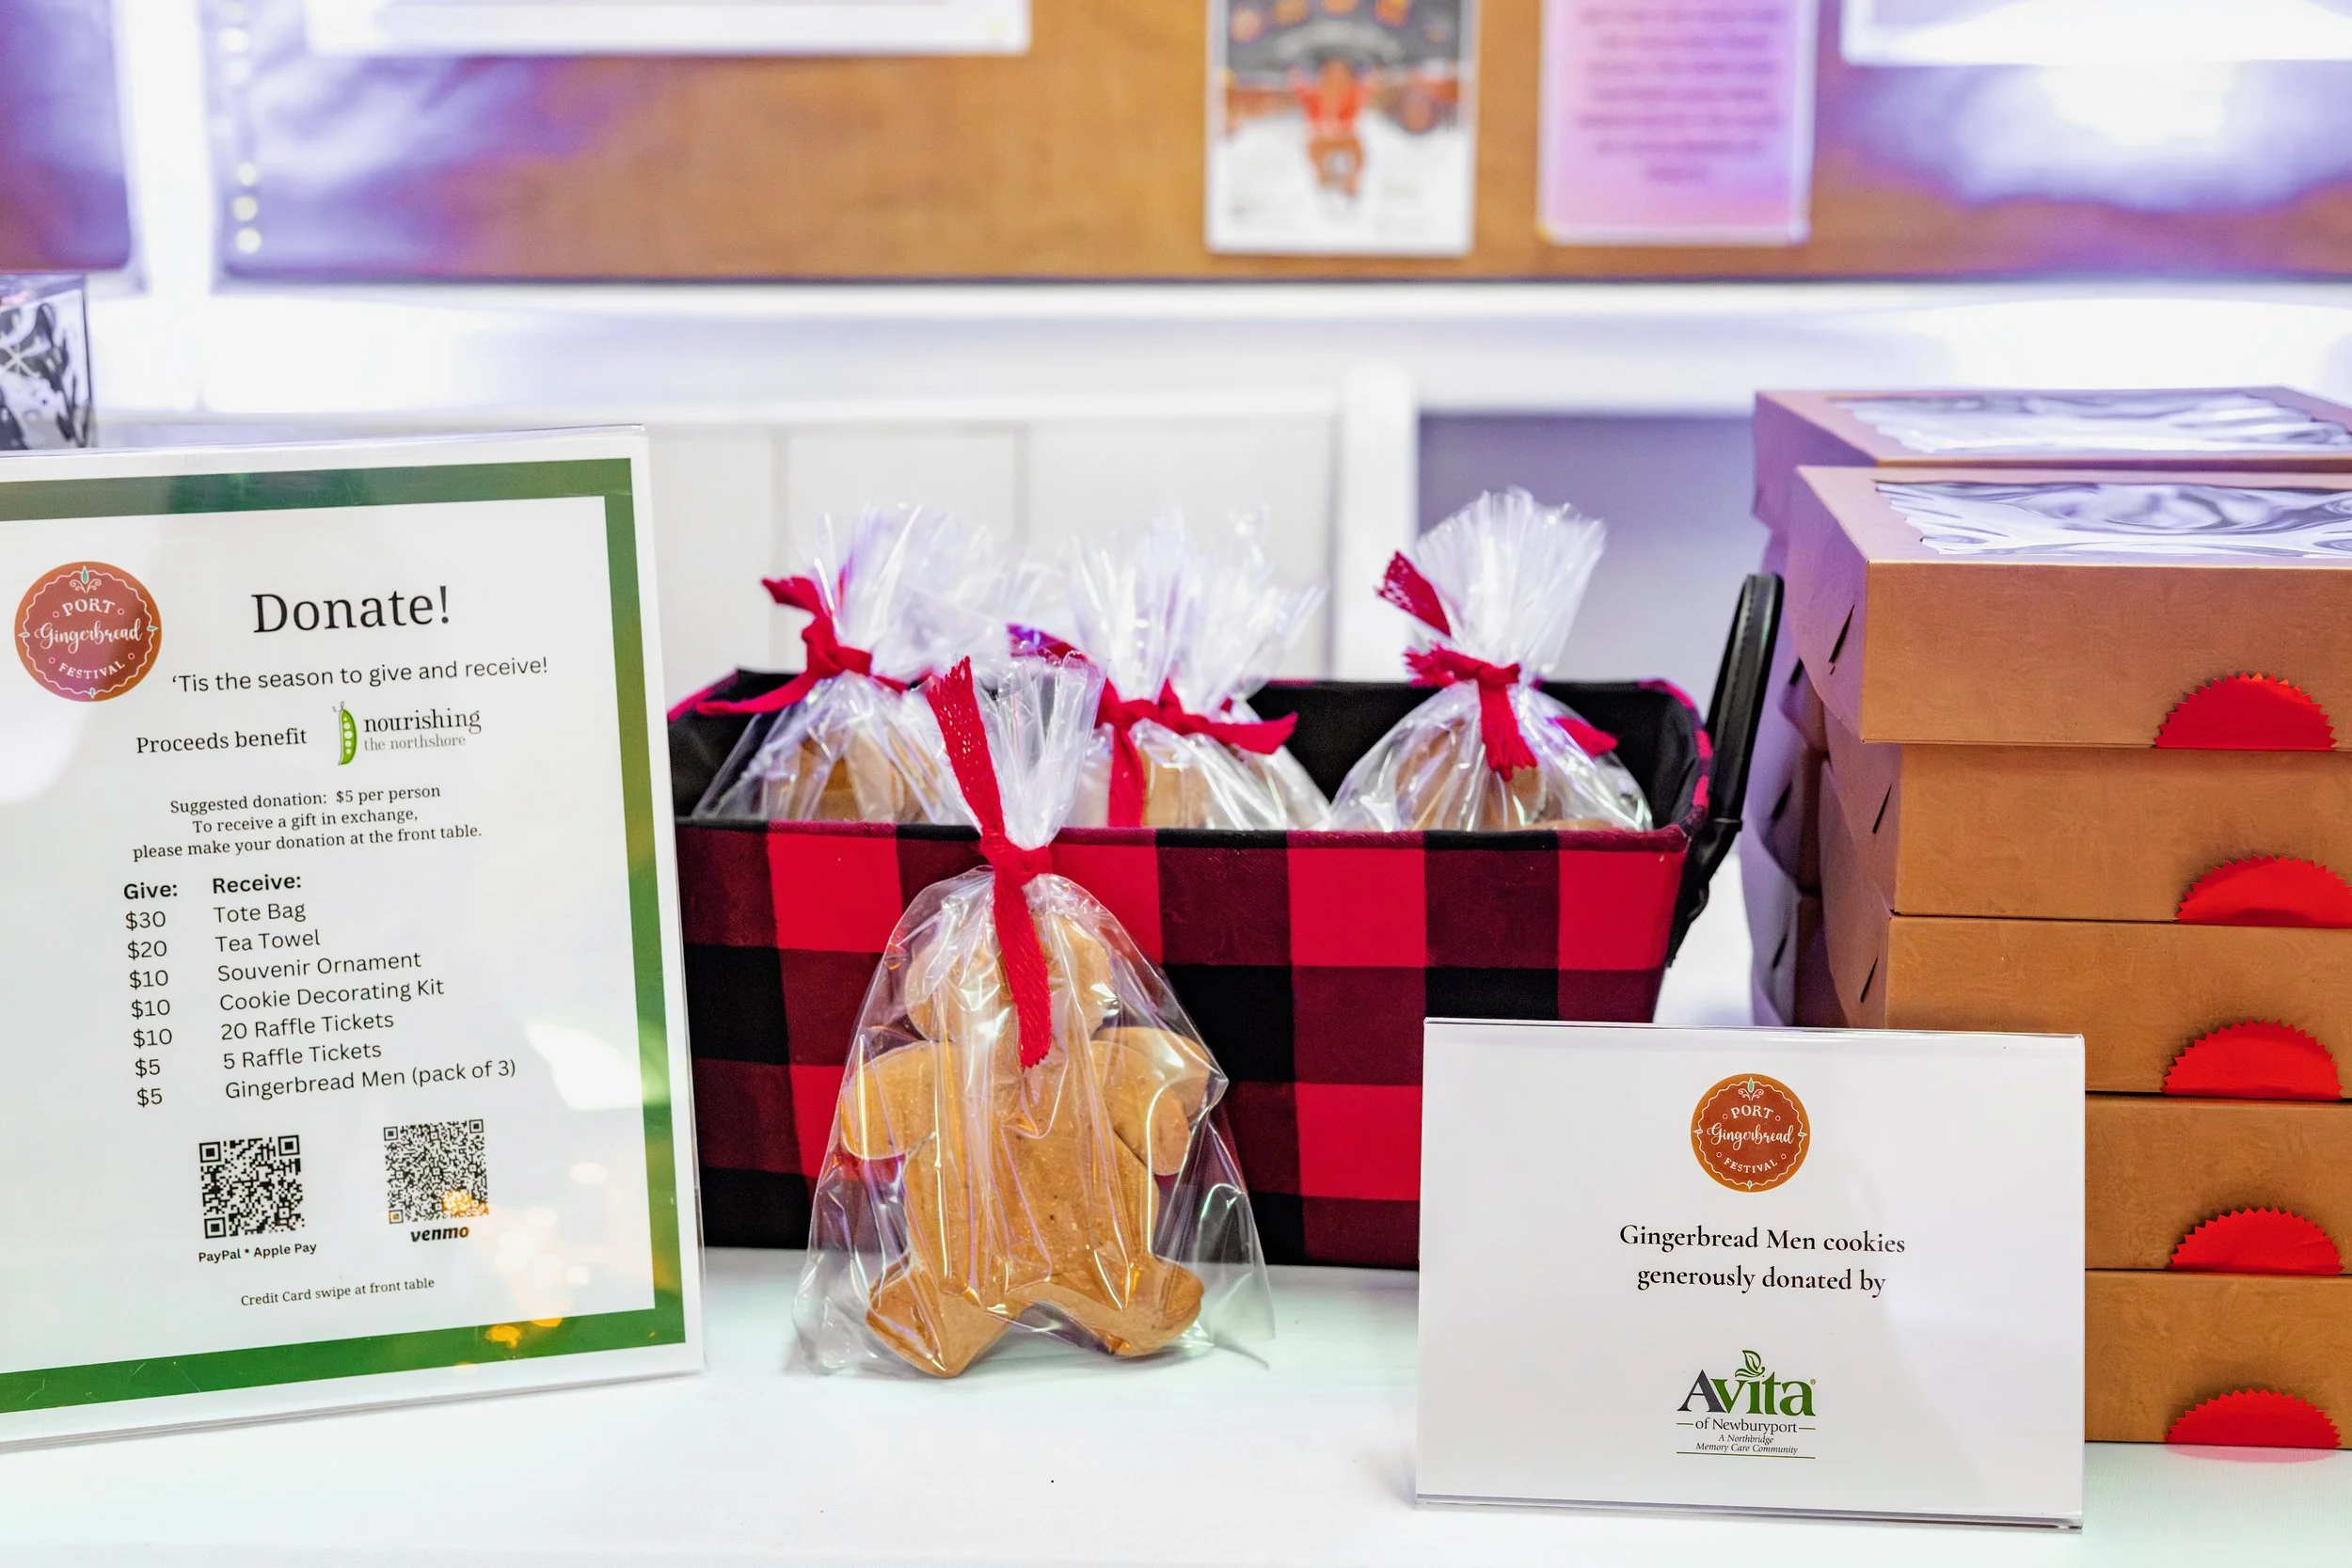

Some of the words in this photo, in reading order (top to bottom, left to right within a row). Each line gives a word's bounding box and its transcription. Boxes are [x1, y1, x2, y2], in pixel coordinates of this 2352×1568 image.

[62, 598, 115, 616] PORT
[251, 586, 448, 633] Donate!
[34, 618, 142, 654] Gingerbread
[58, 660, 125, 679] FESTIVAL
[215, 673, 250, 690] the
[259, 672, 333, 688] season
[341, 669, 361, 684] to
[370, 664, 411, 687] give
[420, 660, 456, 679] and
[466, 657, 547, 676] receive!
[365, 708, 481, 733] nourishing
[137, 733, 229, 753] Proceeds
[235, 728, 307, 748] benefit
[364, 737, 385, 751] the
[390, 734, 465, 750] northshore
[171, 796, 247, 816] Suggested
[253, 793, 326, 808] donation:
[337, 790, 353, 803] $5
[358, 791, 384, 805] per
[389, 787, 440, 803] person
[193, 821, 212, 832] To
[217, 817, 273, 832] receive
[278, 818, 286, 828] a
[292, 814, 316, 831] gift
[322, 813, 336, 825] in
[342, 810, 417, 824] exchange,
[133, 845, 182, 863] please
[188, 841, 230, 855] make
[235, 841, 271, 855] your
[277, 834, 344, 849] donation
[351, 833, 363, 845] at
[370, 831, 392, 843] the
[398, 829, 436, 841] front
[440, 824, 481, 838] table.
[124, 882, 177, 899] Give:
[213, 874, 301, 894] Receive:
[126, 911, 166, 931] $30
[214, 907, 261, 923] Tote
[268, 904, 306, 922] Bag
[128, 941, 167, 960] $20
[215, 936, 252, 952] Tea
[258, 929, 320, 948] Towel
[218, 963, 310, 981] Souvenir
[318, 953, 421, 974] Ornament
[130, 970, 168, 990] $10
[220, 990, 290, 1010] Cookie
[297, 983, 411, 1005] Decorating
[418, 979, 444, 995] Kit
[132, 999, 170, 1020] $10
[222, 1023, 246, 1040] 20
[256, 1018, 315, 1037] Raffle
[321, 1014, 393, 1032] Tickets
[134, 1029, 172, 1049] $10
[224, 1053, 234, 1069] 5
[243, 1048, 302, 1068] Raffle
[309, 1044, 381, 1062] Tickets
[135, 1058, 160, 1078] $5
[226, 1072, 354, 1100] Gingerbread
[362, 1071, 405, 1087] Men
[413, 1064, 466, 1087] (pack
[472, 1061, 492, 1078] of
[499, 1059, 515, 1077] 3)
[137, 1087, 162, 1107] $5
[1731, 1105, 1773, 1119] PORT
[1707, 1123, 1794, 1150] Gingerbread
[1724, 1158, 1777, 1173] FESTIVAL
[411, 1227, 469, 1242] venmo
[1620, 1225, 1758, 1252] Gingerbread
[1767, 1229, 1816, 1249] Men
[1824, 1230, 1904, 1252] cookies
[199, 1249, 241, 1263] PayPal
[254, 1245, 291, 1259] Apple
[294, 1243, 316, 1255] Pay
[1638, 1265, 1756, 1293] generously
[1762, 1266, 1851, 1290] donated
[1860, 1269, 1885, 1298] by
[241, 1292, 278, 1306] Credit
[282, 1289, 311, 1302] Card
[315, 1287, 351, 1300] swipe
[355, 1286, 366, 1294] at
[371, 1282, 400, 1293] front
[405, 1278, 434, 1290] table
[1695, 1418, 1710, 1429] of
[1713, 1418, 1797, 1435] Newburyport
[1696, 1443, 1727, 1452] Memory
[1753, 1445, 1798, 1455] Community
[1727, 1434, 1773, 1445] Northbridge
